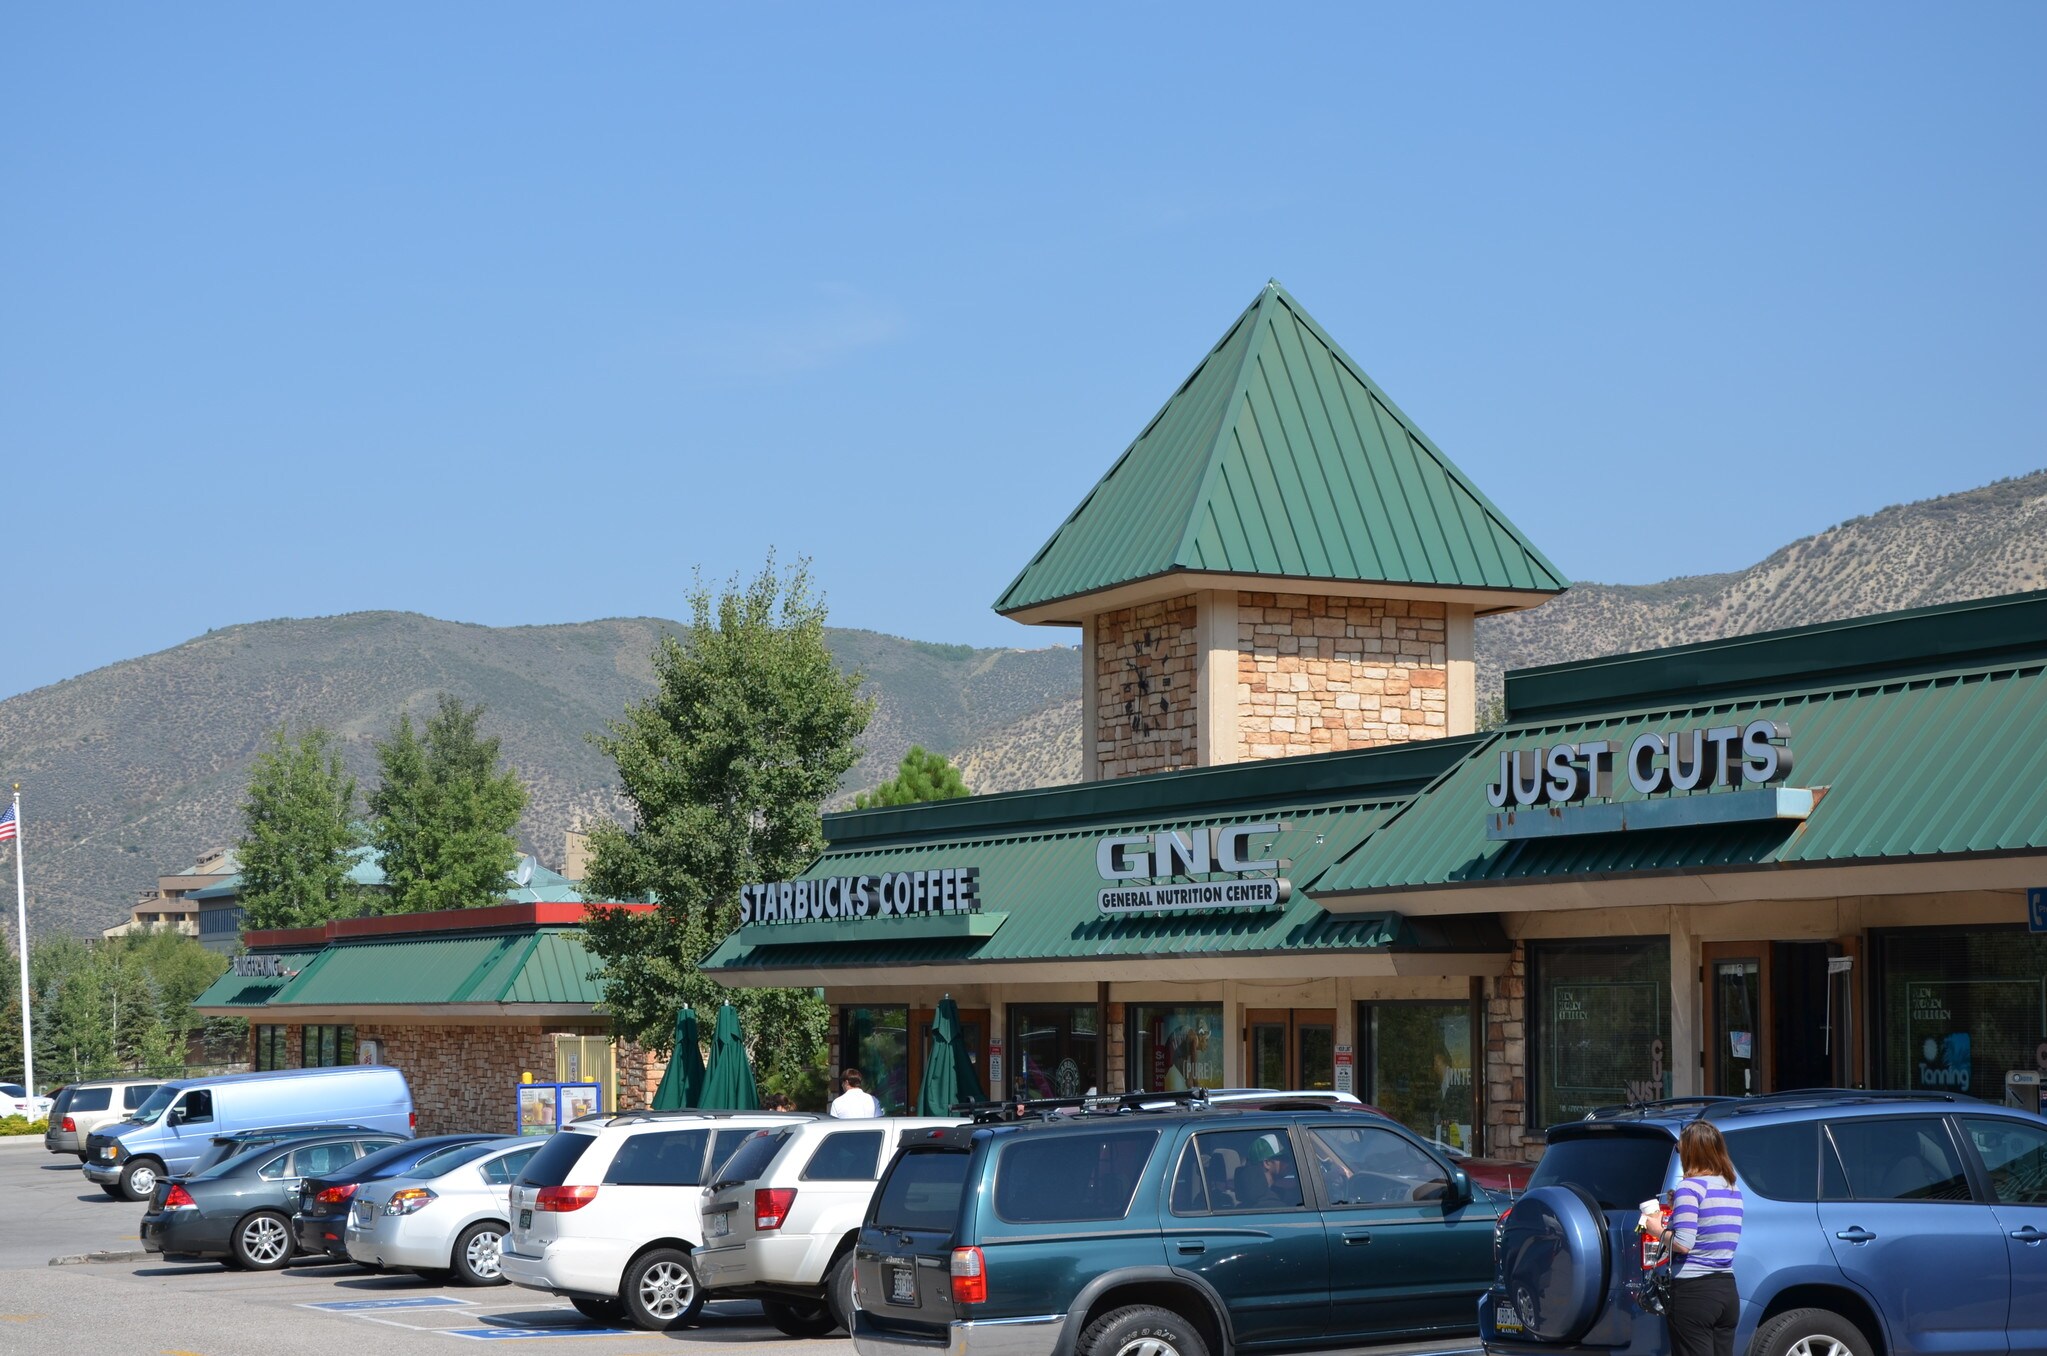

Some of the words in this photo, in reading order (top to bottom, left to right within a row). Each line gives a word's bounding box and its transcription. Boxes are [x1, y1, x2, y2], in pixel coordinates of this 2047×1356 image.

[1486, 739, 1614, 808] JUST
[1627, 719, 1787, 795] CUTS
[1096, 822, 1285, 880] GNC
[740, 874, 875, 923] STARBUCKS
[879, 867, 975, 915] COFFEE
[1102, 891, 1153, 909] GENERAL
[1156, 886, 1223, 906] NUTRITION
[1226, 883, 1273, 902] CENTER
[1918, 1063, 1970, 1092] Tanning
